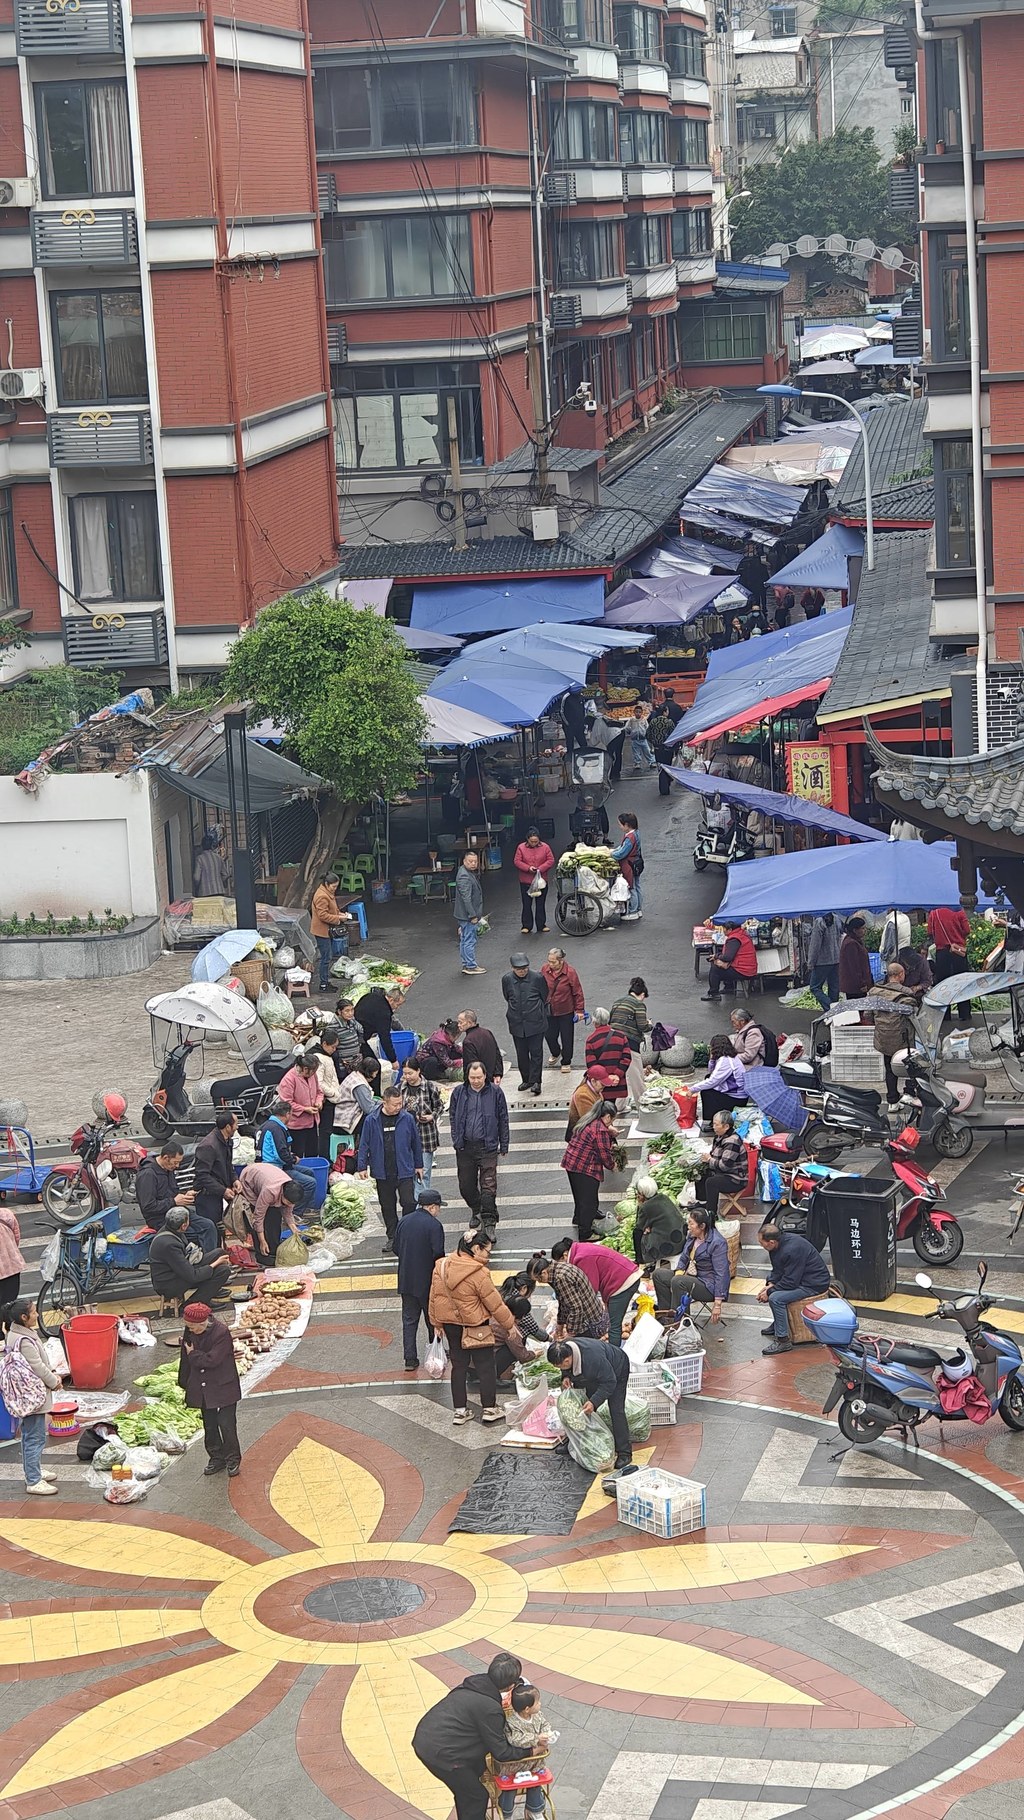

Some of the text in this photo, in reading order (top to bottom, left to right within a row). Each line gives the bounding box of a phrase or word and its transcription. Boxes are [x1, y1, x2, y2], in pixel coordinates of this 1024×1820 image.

[801, 763, 824, 790] 酒
[850, 1218, 862, 1259] 马边环卫
